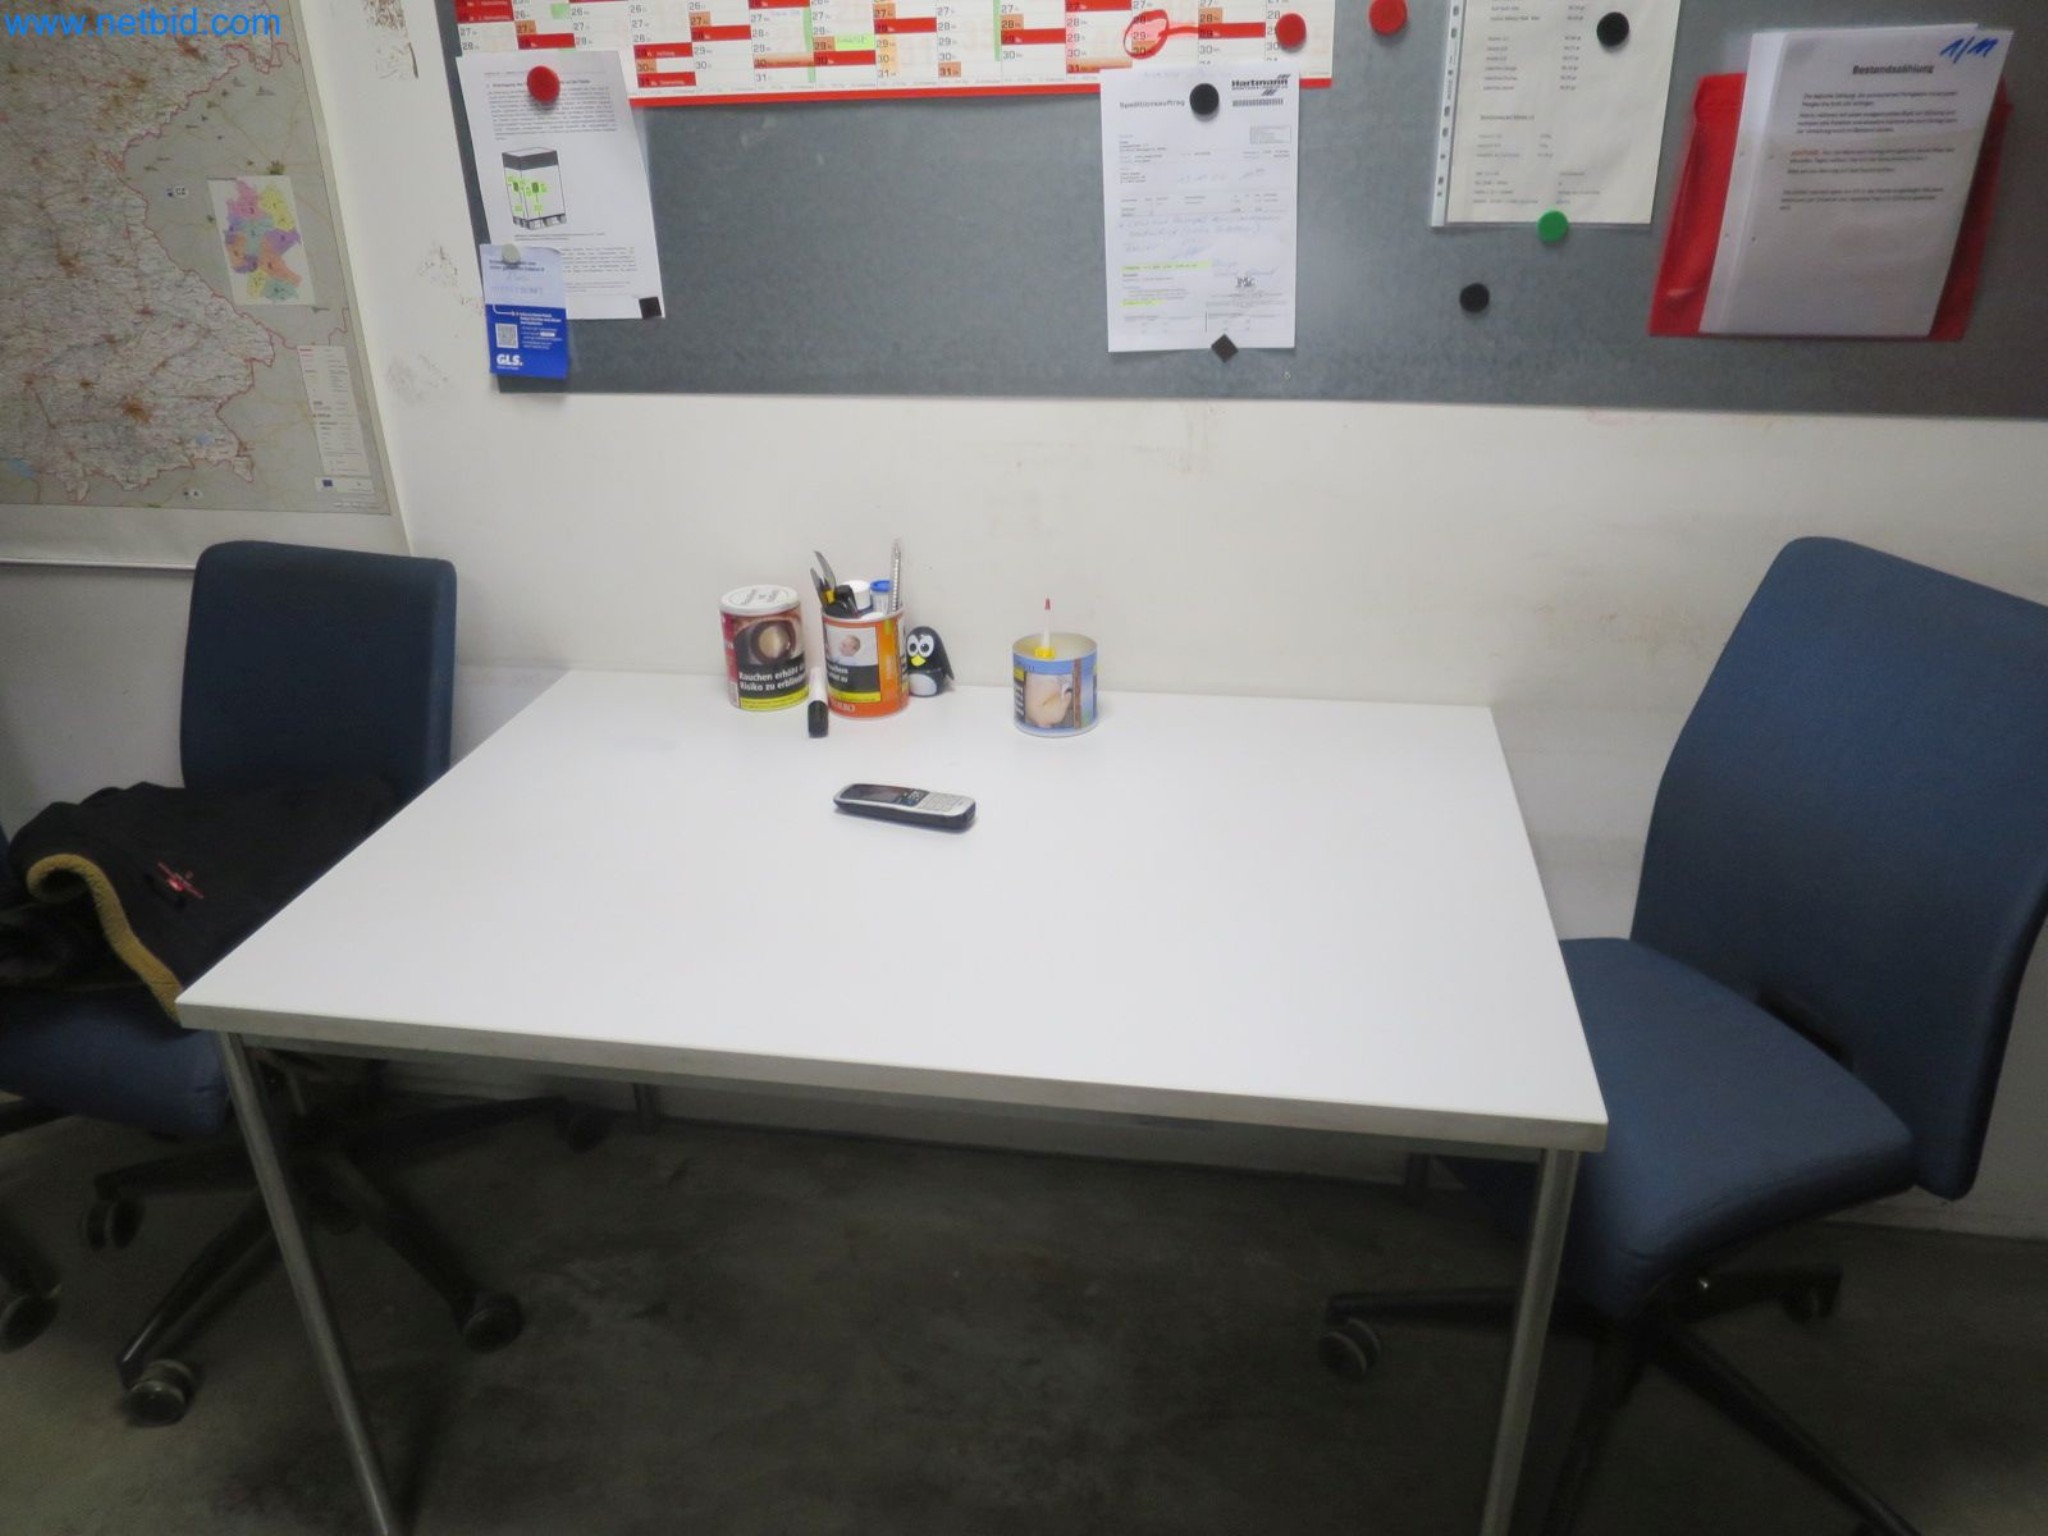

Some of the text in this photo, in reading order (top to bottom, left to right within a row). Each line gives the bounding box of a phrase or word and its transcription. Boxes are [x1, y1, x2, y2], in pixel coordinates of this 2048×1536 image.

[1853, 64, 1935, 74] Bestandszählung
[1232, 78, 1289, 87] Hartmann
[739, 671, 773, 681] Rauchen
[740, 680, 764, 691] Risiko
[765, 682, 775, 690] zu
